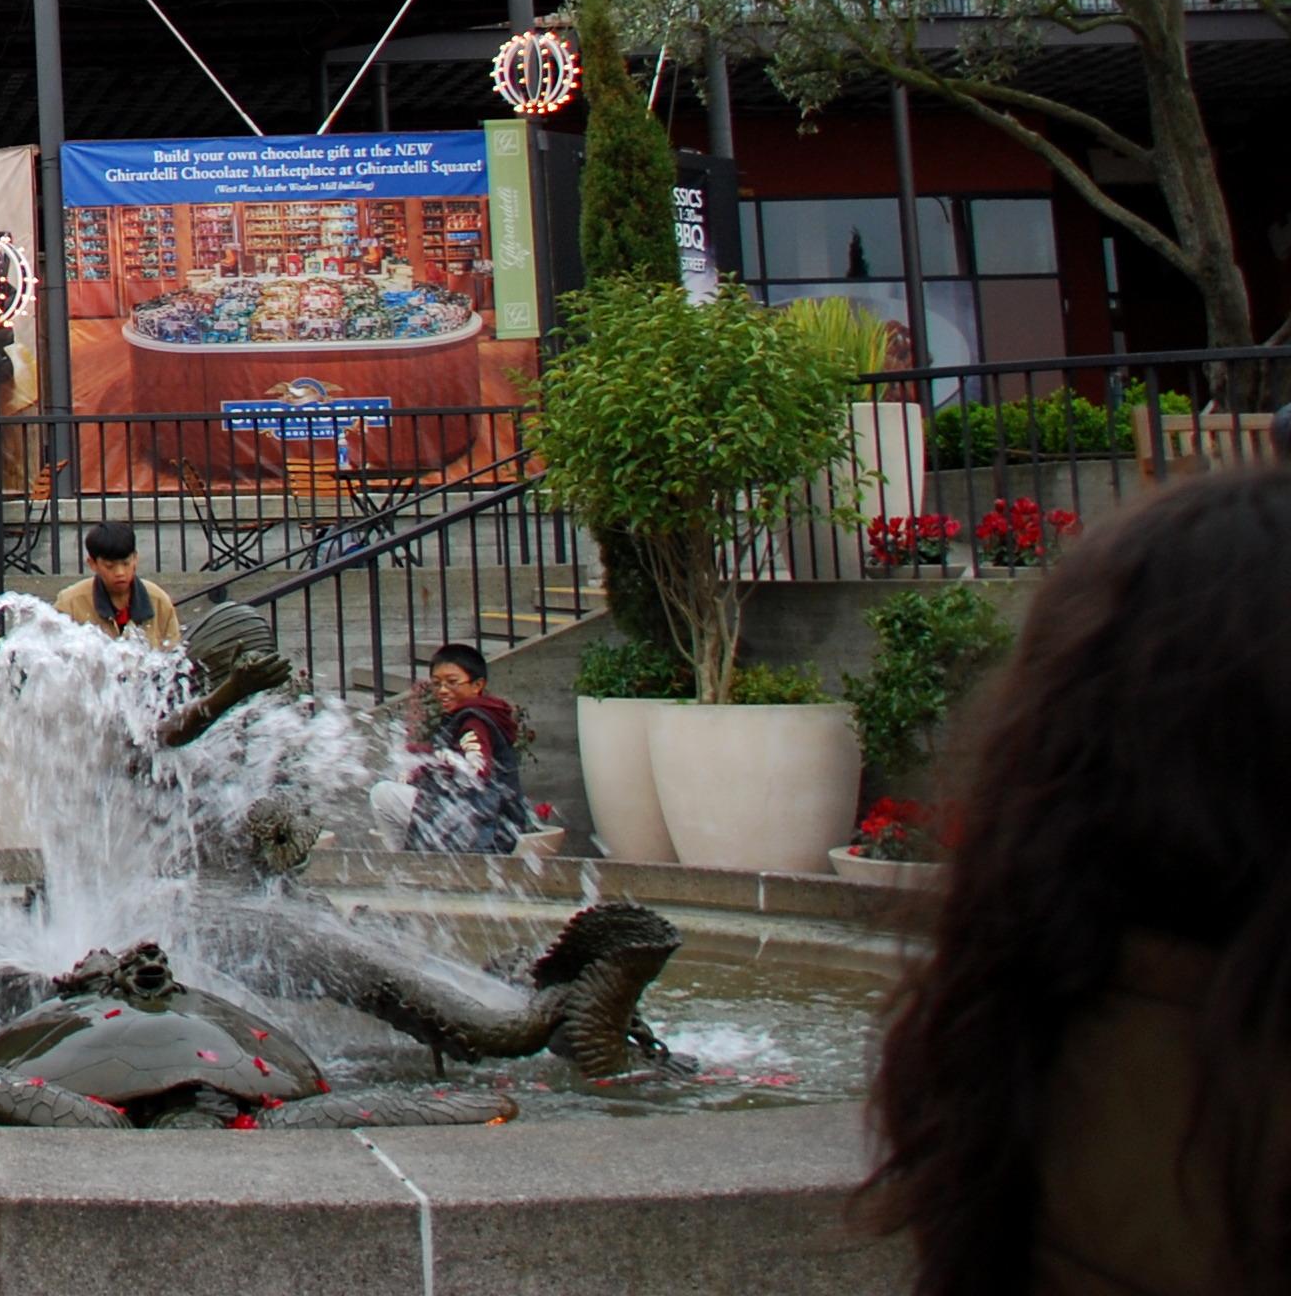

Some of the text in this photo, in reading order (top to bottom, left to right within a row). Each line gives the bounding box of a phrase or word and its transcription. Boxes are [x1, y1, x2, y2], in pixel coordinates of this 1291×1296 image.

[153, 143, 433, 166] Build your own chocolate gift at the NEW
[105, 159, 483, 182] Ghirardelli Chocolate Marketplace at Ghirardelli Square!
[675, 222, 706, 252] BBQ
